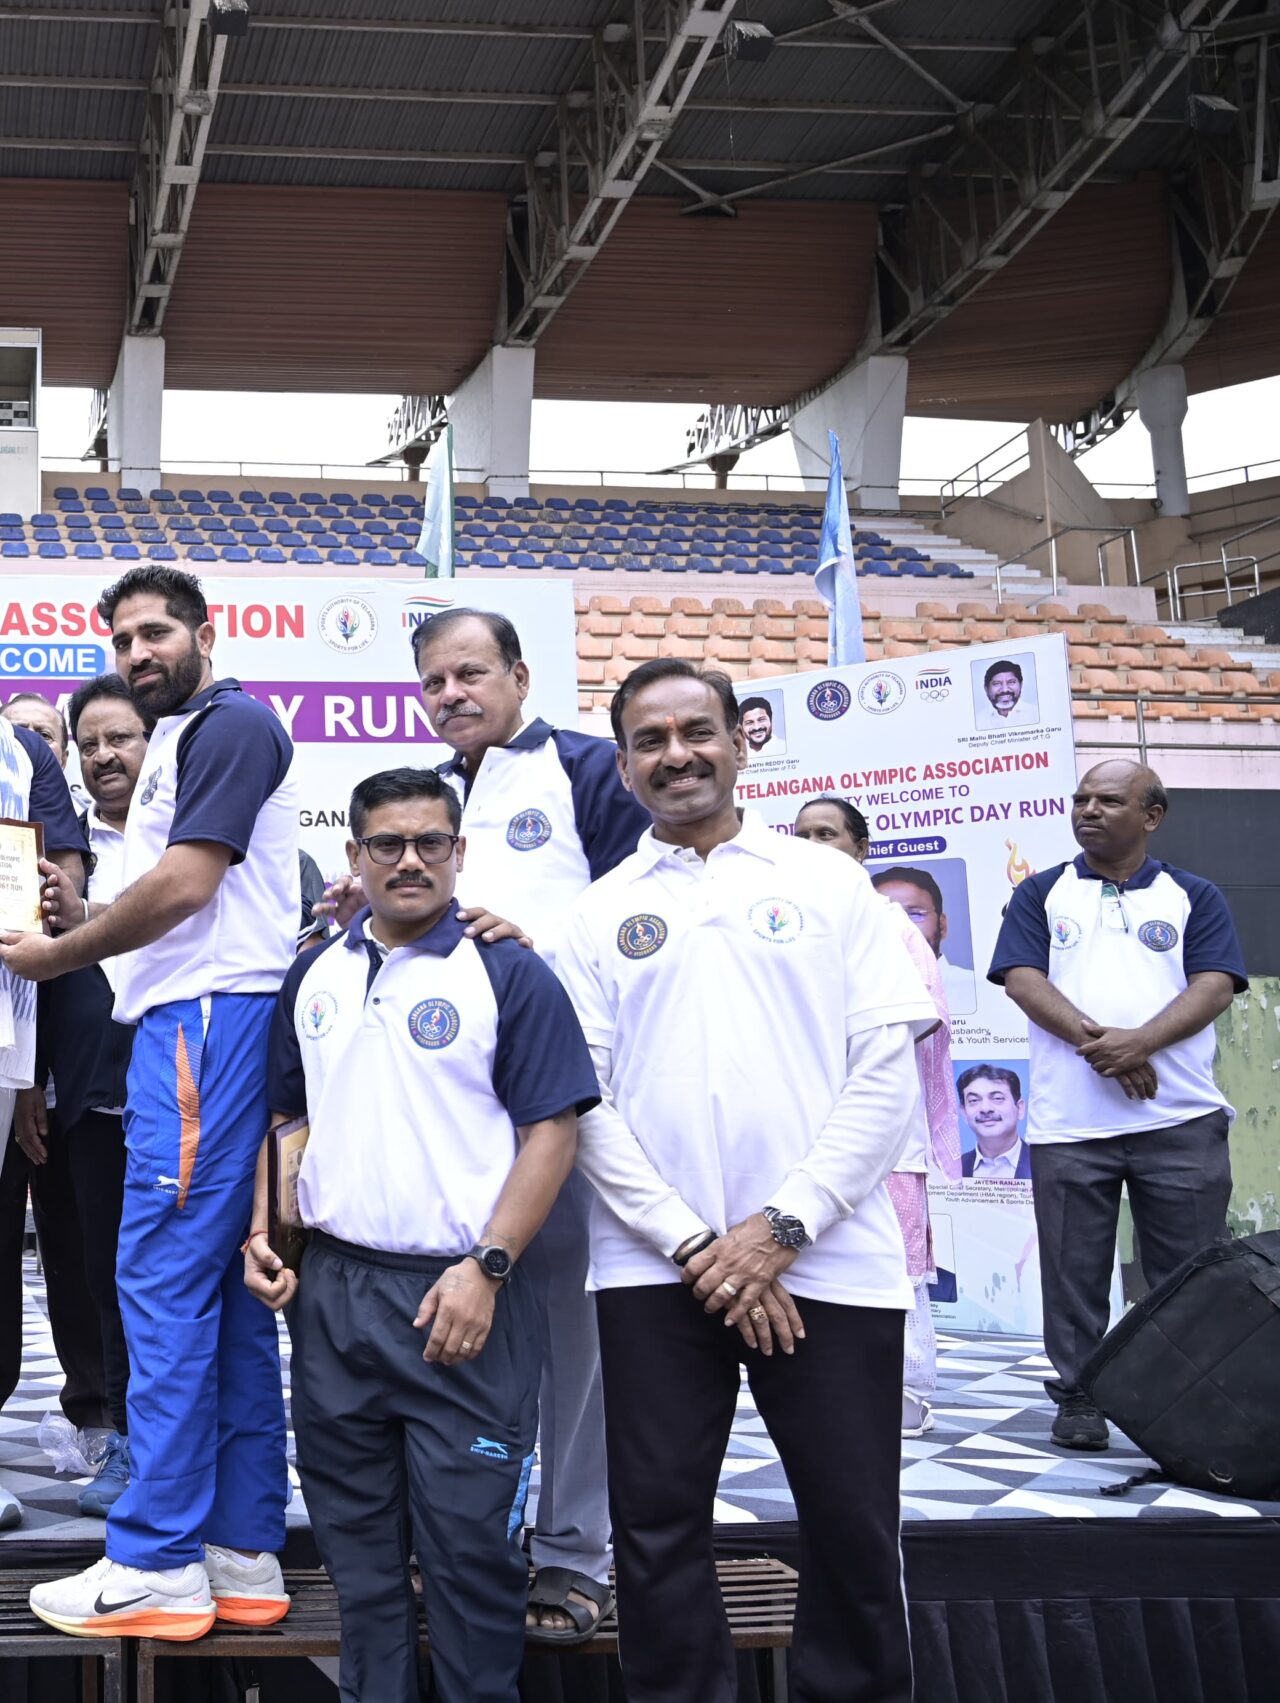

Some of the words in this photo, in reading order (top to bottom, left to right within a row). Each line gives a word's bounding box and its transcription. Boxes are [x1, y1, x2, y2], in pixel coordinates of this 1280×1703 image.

[915, 676, 952, 690] INDIA
[324, 695, 440, 738] RUN
[736, 775, 836, 801] TELANGANA
[840, 766, 918, 790] OLYMPIC
[922, 751, 1049, 781] ASSOCIATION
[869, 787, 945, 807] WELCOME
[949, 784, 971, 798] TO
[875, 807, 965, 832] OLYMPIC
[970, 802, 1012, 823] DAY
[1020, 797, 1066, 818] RUN
[868, 843, 894, 857] hief
[897, 839, 940, 854] Guest
[11, 875, 19, 883] OF
[966, 1036, 991, 1044] Youth
